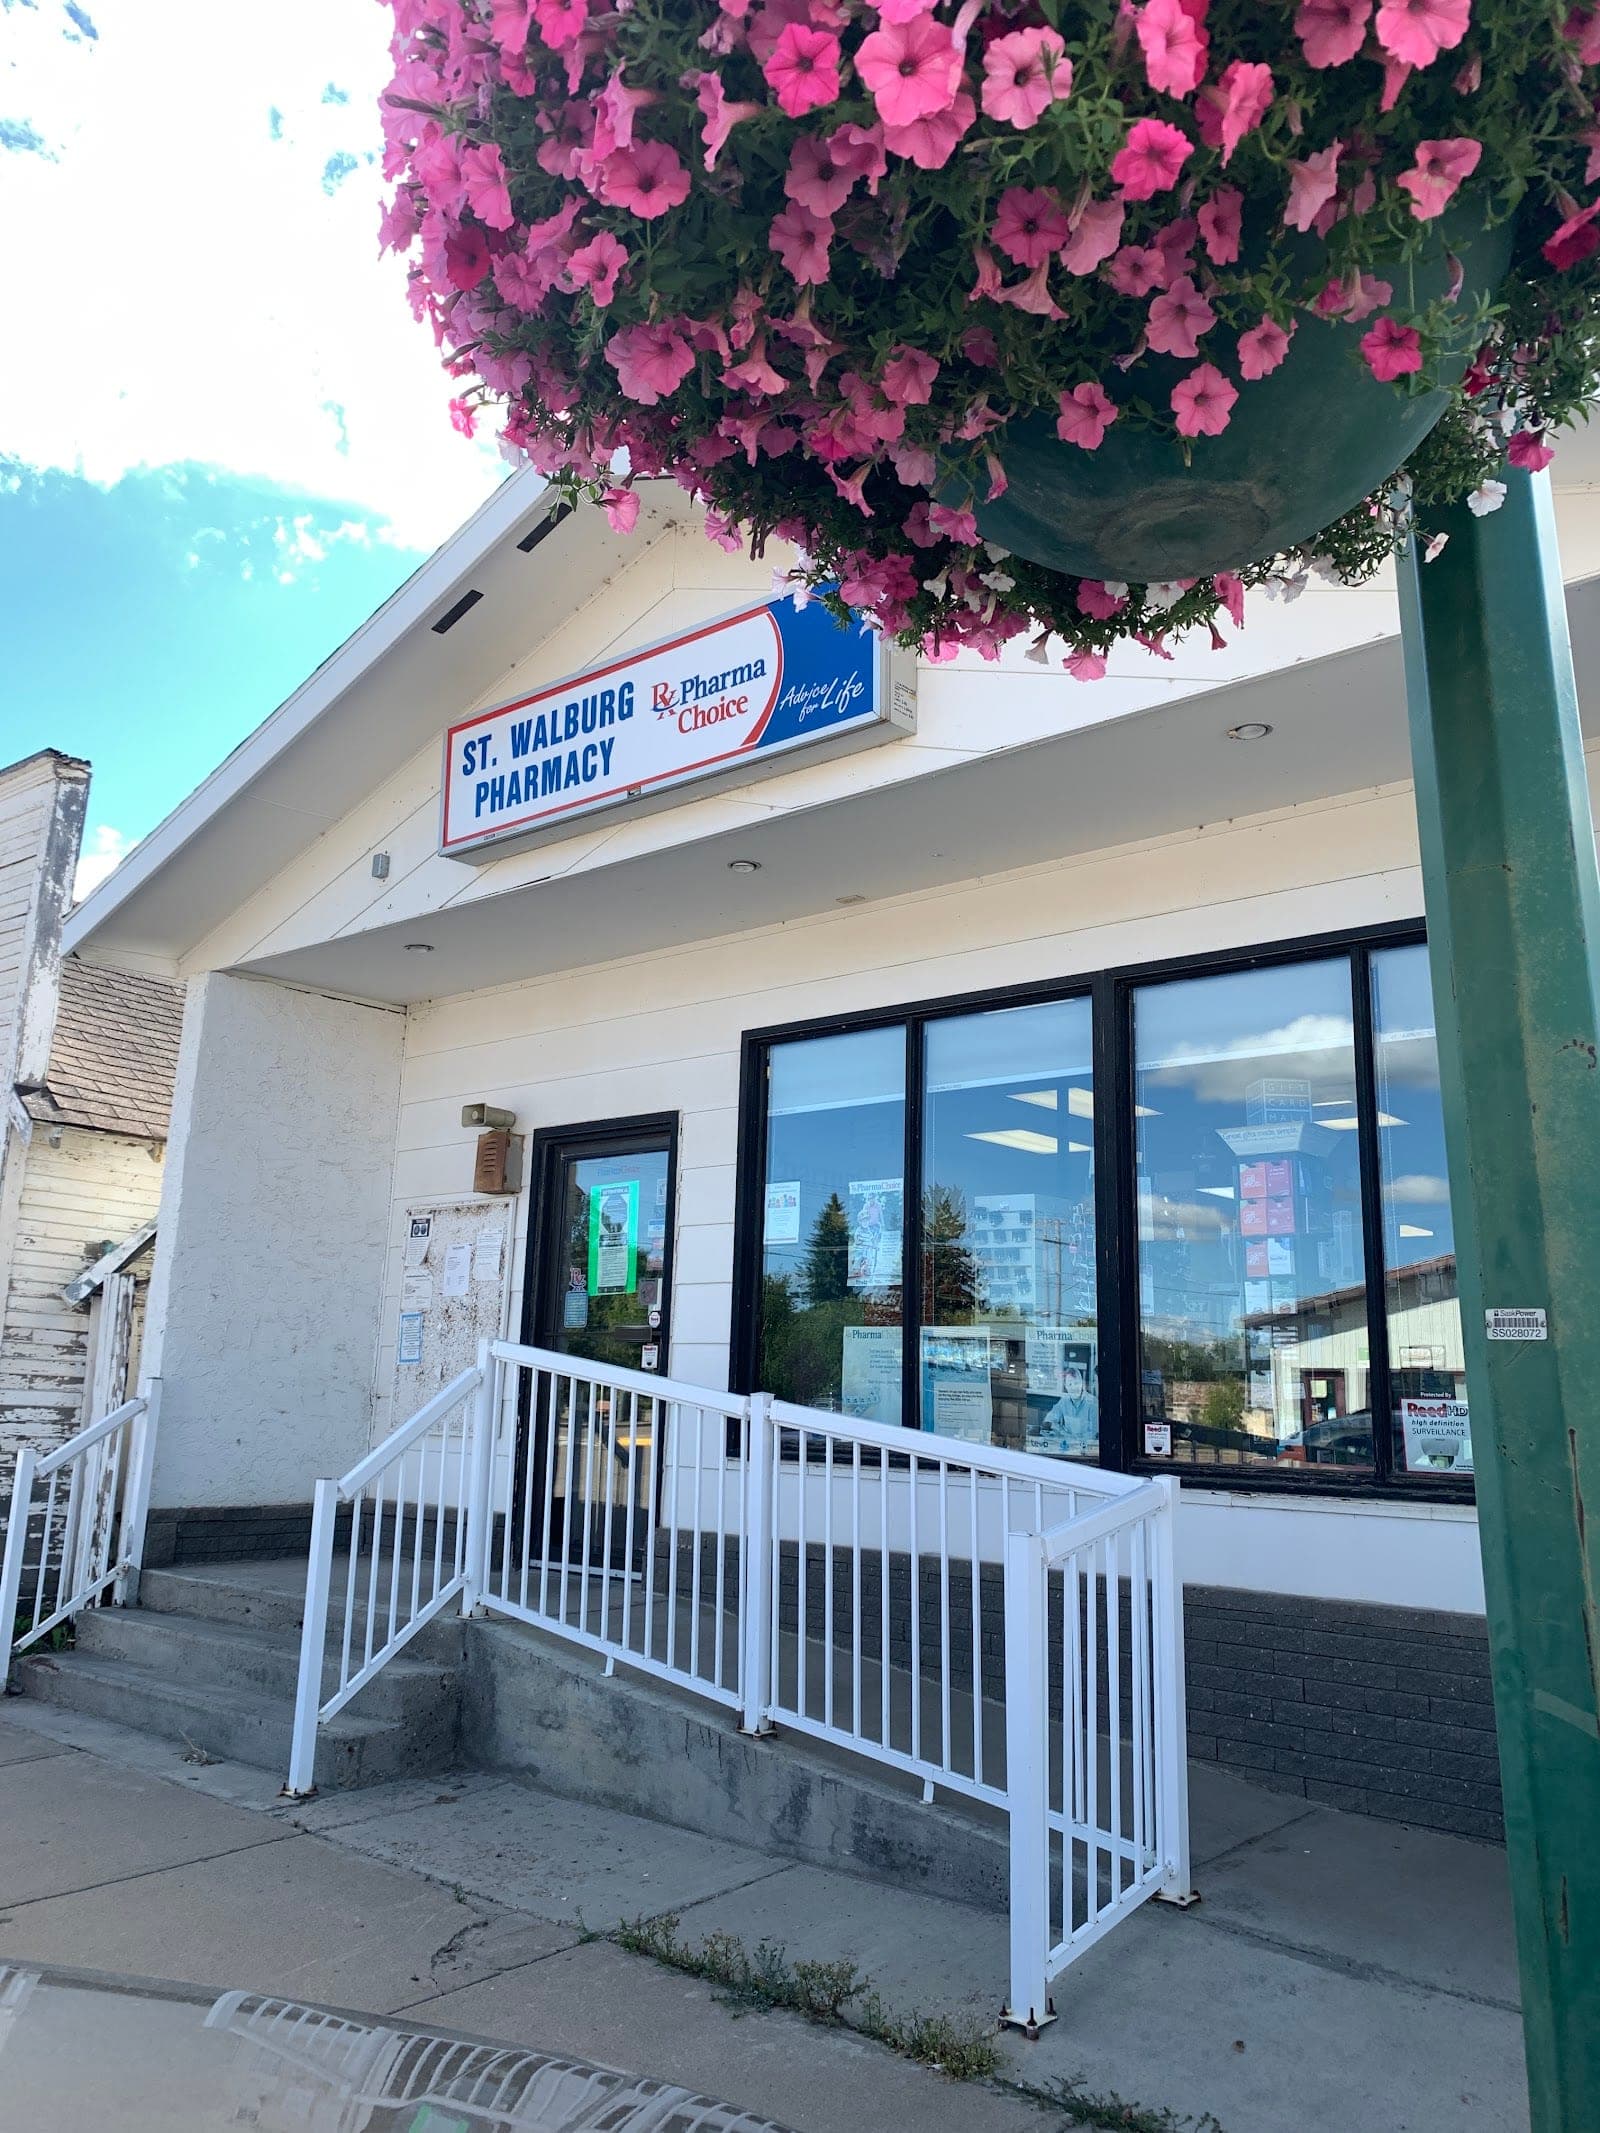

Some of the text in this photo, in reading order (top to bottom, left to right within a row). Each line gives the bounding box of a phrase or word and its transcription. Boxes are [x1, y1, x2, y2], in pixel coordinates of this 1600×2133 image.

[679, 658, 767, 706] Pharma
[779, 682, 829, 711] Advice
[820, 670, 865, 714] Life
[462, 681, 634, 776] ST. WALBURG
[677, 695, 749, 734] Choice
[798, 699, 819, 722] for
[475, 736, 616, 818] PHARMACY
[1492, 1328, 1542, 1338] SS028072
[1412, 1427, 1466, 1436] SURVEILLANCE
